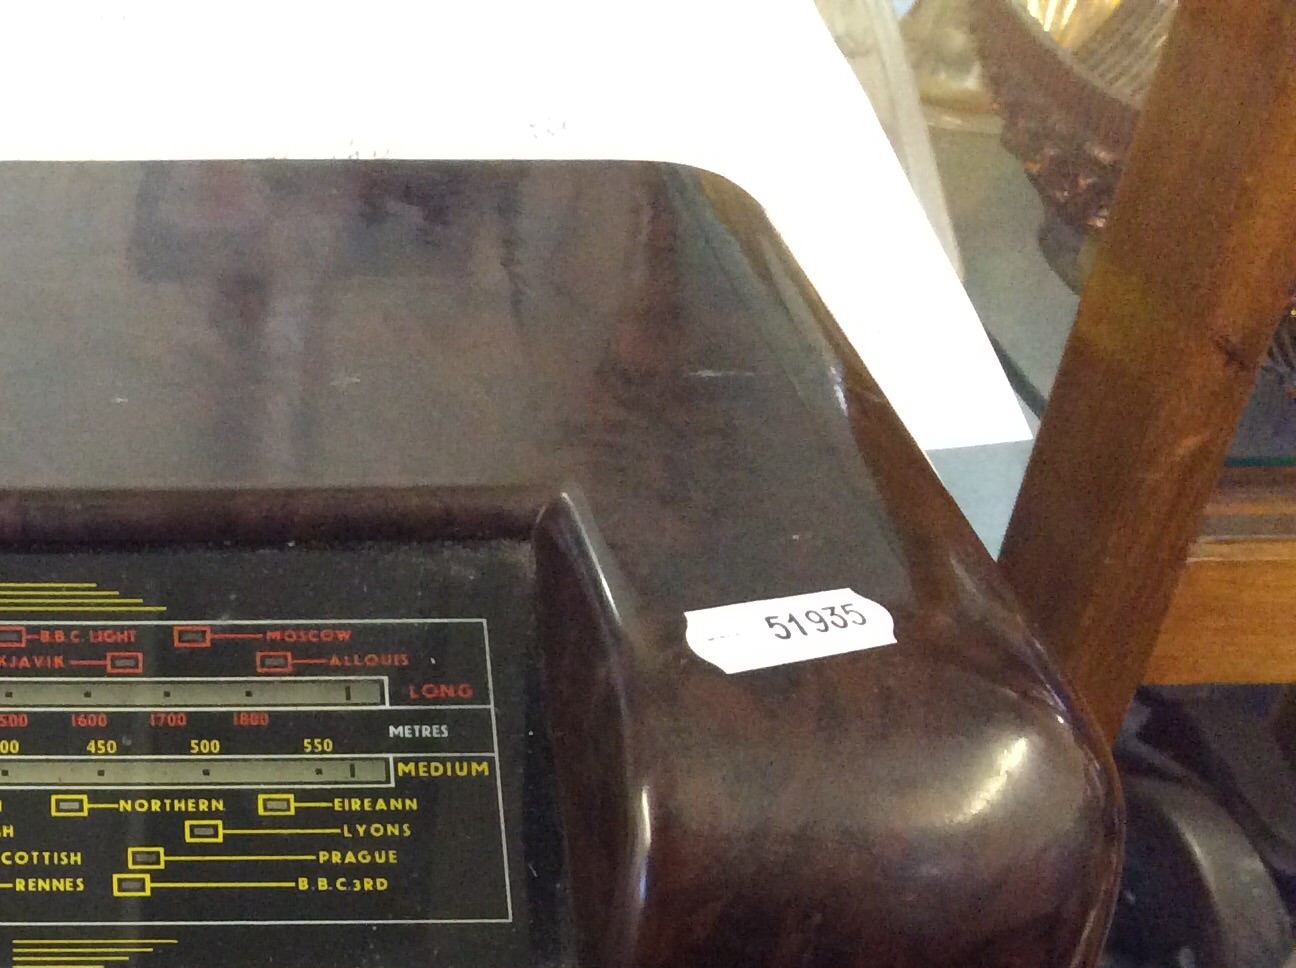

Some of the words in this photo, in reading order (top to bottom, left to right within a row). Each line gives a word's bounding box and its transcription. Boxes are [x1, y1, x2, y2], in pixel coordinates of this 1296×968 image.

[764, 603, 867, 640] 51935
[89, 630, 137, 643] LIGHT
[266, 630, 352, 643] MOSCOW
[329, 653, 409, 666] ALLOUIS
[408, 683, 473, 698] LONG
[71, 713, 107, 727] 1600
[150, 712, 187, 727] 1700
[233, 712, 269, 726] 1800
[389, 724, 449, 738] METRES
[86, 740, 117, 753] 450
[190, 739, 220, 753] 500
[304, 739, 333, 752] 550
[398, 761, 490, 777] MEDIUM
[119, 798, 224, 812] NORTHERN
[333, 798, 418, 811] EIREANN
[343, 823, 411, 837] LYONS
[319, 850, 398, 864] PRAGUE
[15, 878, 84, 892] RENNES
